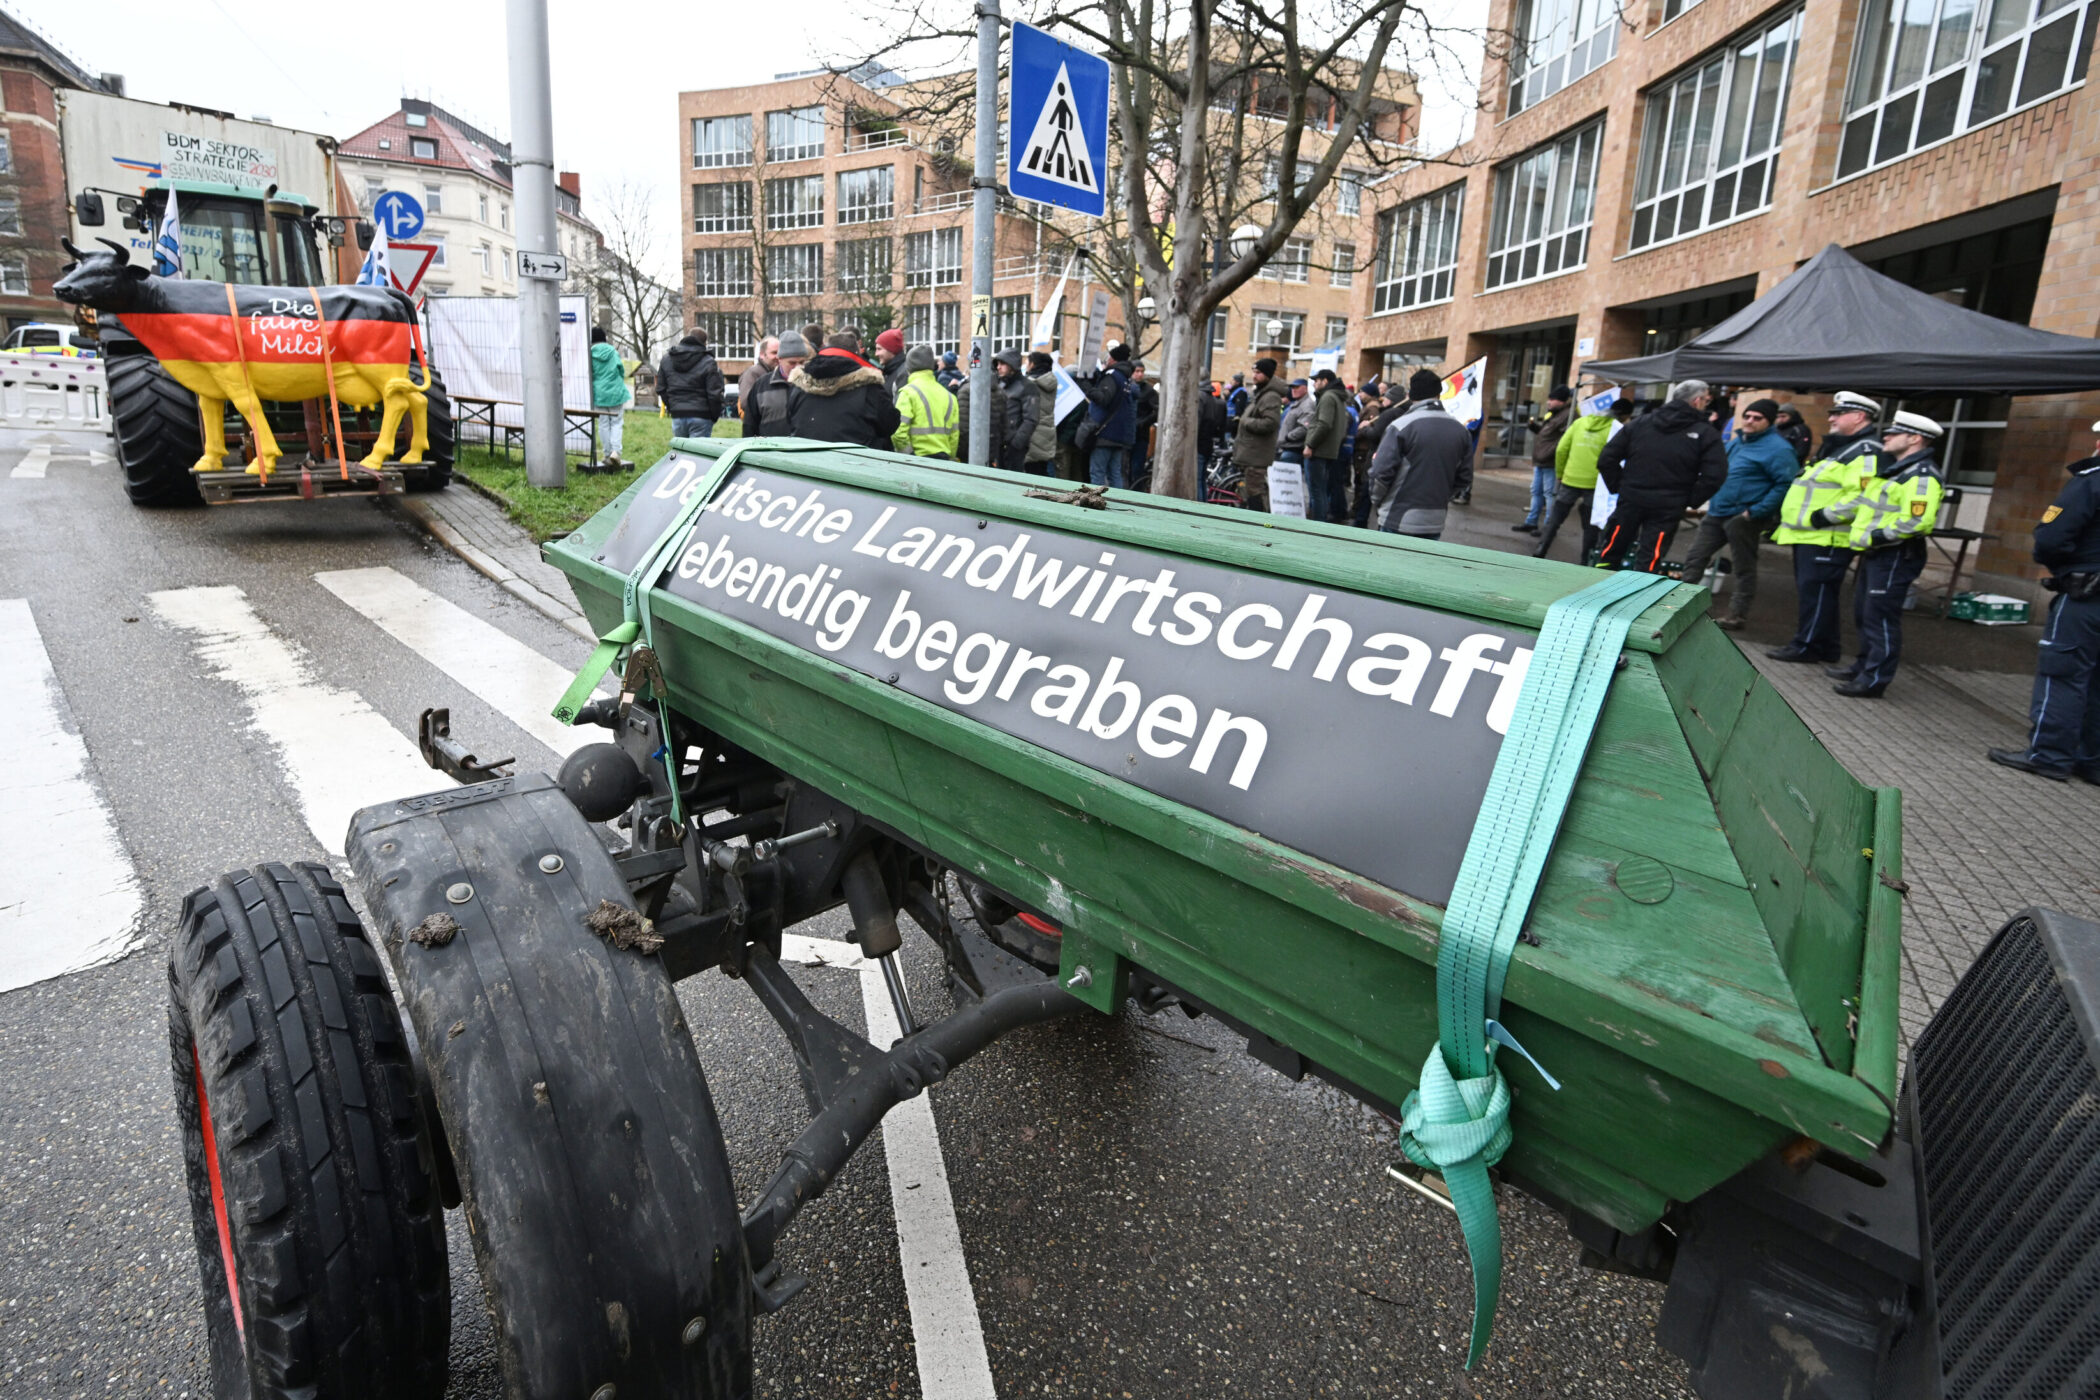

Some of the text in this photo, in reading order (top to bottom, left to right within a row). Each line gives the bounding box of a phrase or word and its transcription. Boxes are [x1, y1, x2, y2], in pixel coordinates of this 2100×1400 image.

[167, 132, 264, 163] BDM SEKTOR-
[174, 149, 278, 178] STRATEGIE 2030
[268, 297, 318, 316] Die
[248, 310, 320, 335] faire
[261, 333, 336, 356] Milch
[852, 505, 1535, 736] Landwirtschaft
[665, 525, 1268, 791] lebendig begraben
[403, 781, 512, 811] FENDT
